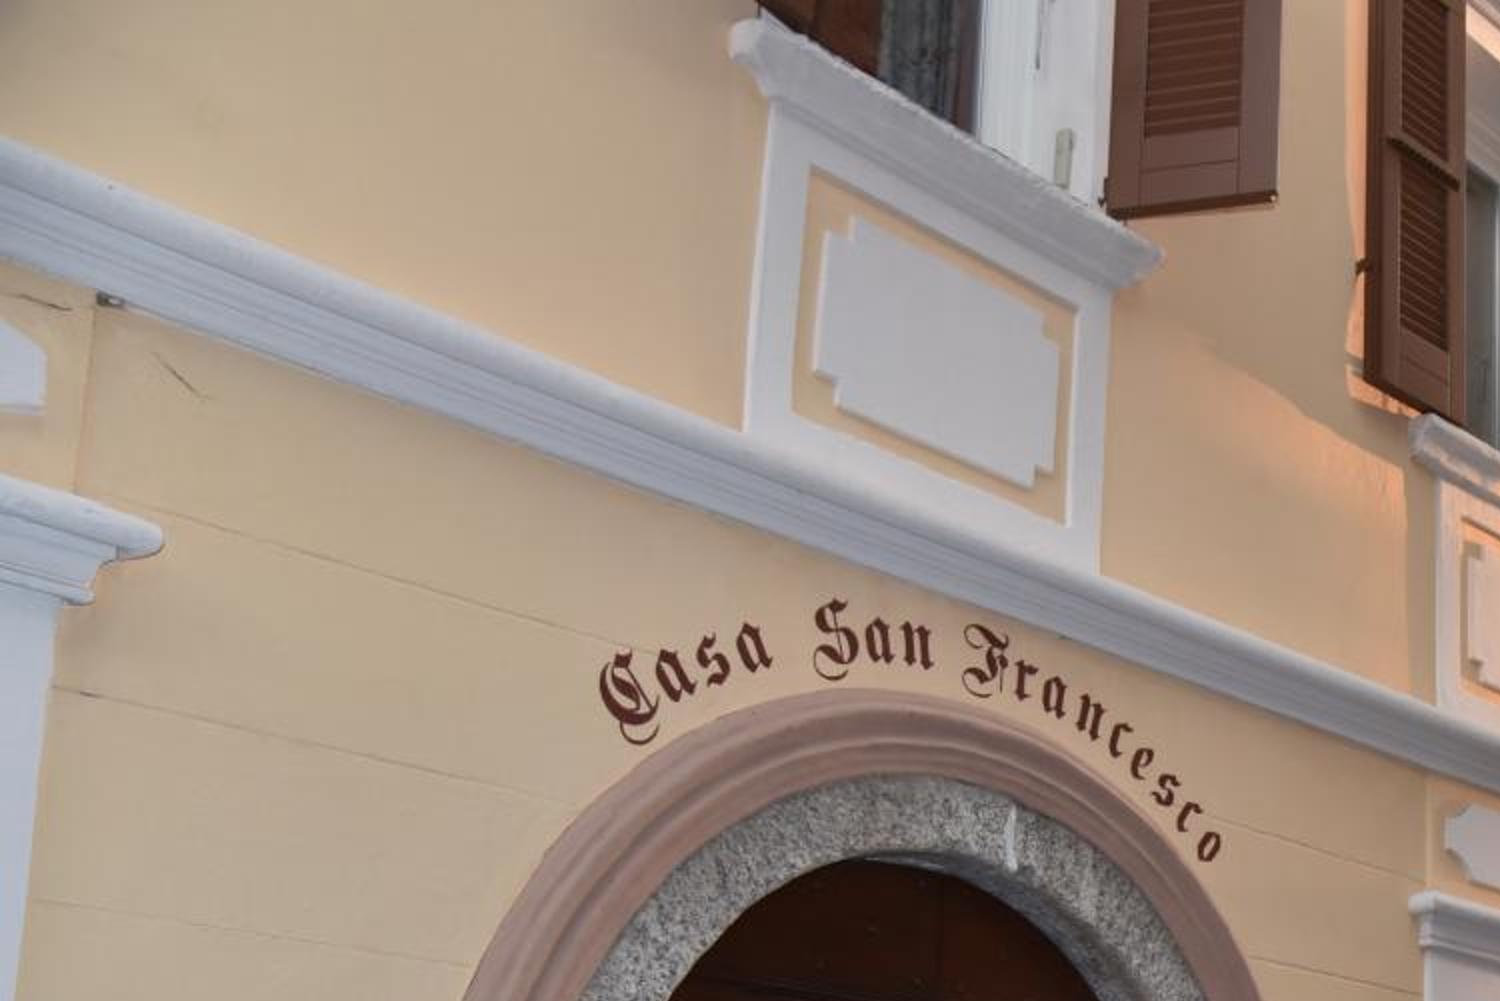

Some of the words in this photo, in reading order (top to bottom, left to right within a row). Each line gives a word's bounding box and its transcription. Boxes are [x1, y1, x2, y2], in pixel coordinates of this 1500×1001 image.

[600, 622, 773, 745] Casa
[814, 599, 934, 681] San
[962, 623, 1222, 863] Francesco
